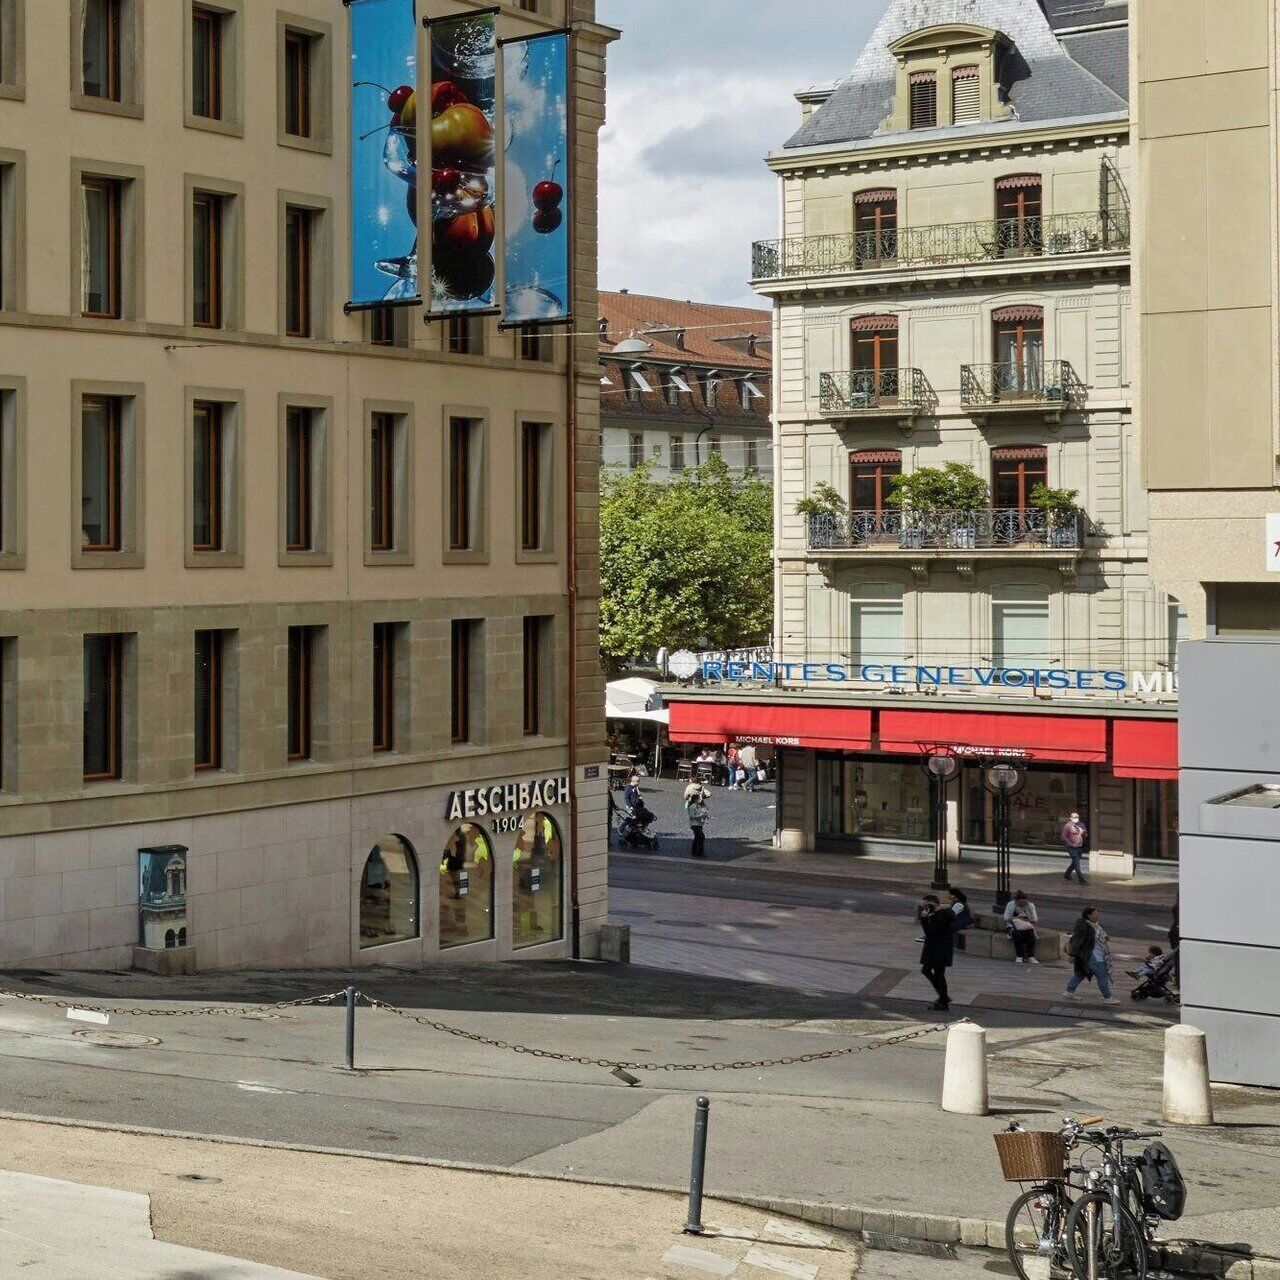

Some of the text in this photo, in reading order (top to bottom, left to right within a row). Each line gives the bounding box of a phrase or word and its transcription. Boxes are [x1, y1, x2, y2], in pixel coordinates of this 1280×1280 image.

[702, 660, 1127, 691] RENTES GENEVOISES
[1132, 670, 1178, 693] MI
[735, 735, 800, 745] MICHAEL KORS
[954, 745, 995, 756] MICHAEL
[448, 777, 570, 821] AESCHBACH
[495, 816, 525, 834] 1904
